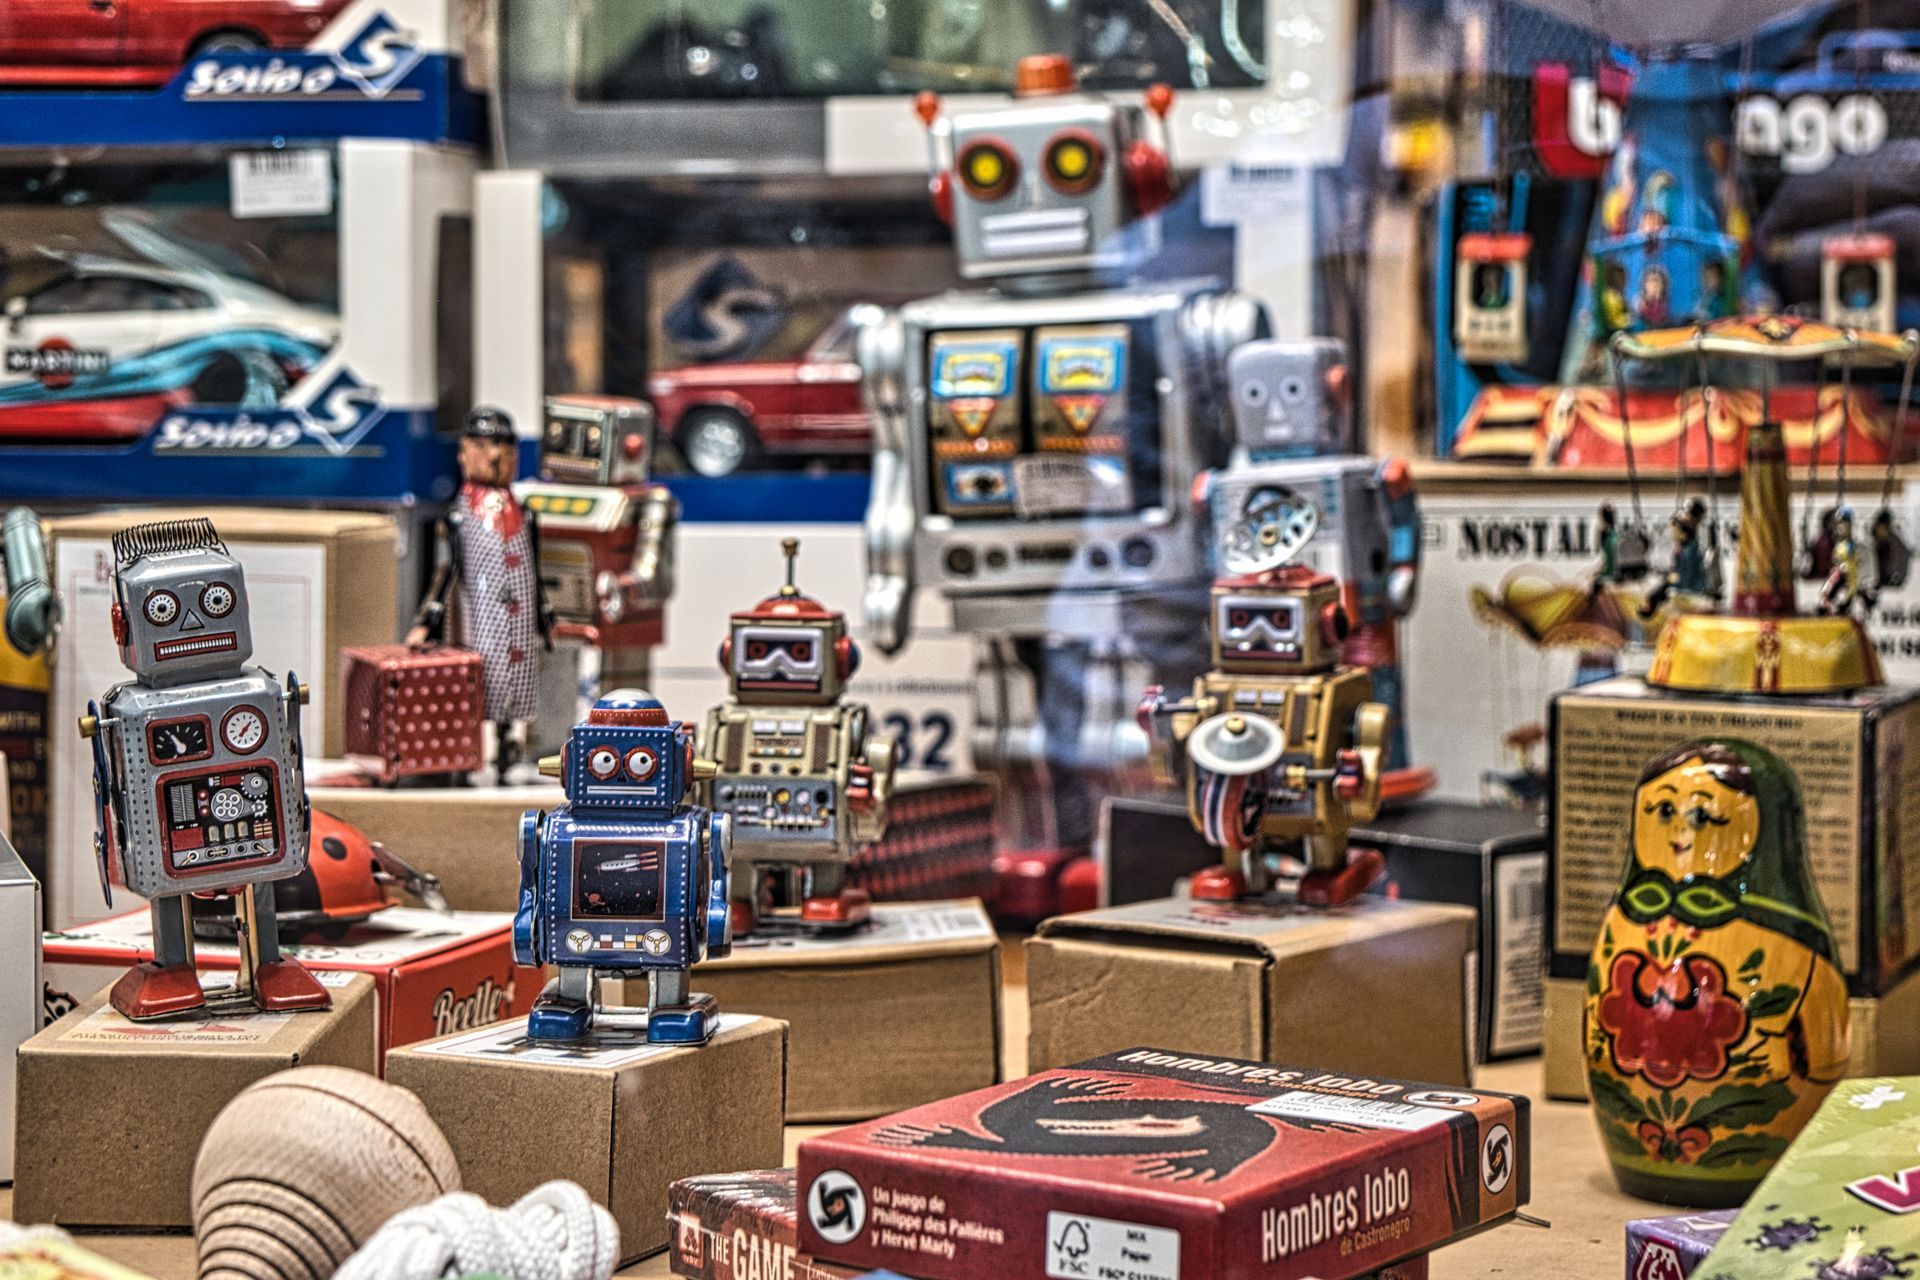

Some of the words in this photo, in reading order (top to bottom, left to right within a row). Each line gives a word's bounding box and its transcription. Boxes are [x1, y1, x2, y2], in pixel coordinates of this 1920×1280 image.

[432, 976, 503, 1037] Beetle
[1116, 1050, 1304, 1082] Hombres
[1302, 1074, 1404, 1095] lobo
[872, 1186, 890, 1204] Un
[928, 1195, 946, 1214] de
[1261, 1185, 1359, 1263] Hombres
[1364, 1165, 1410, 1224] lobo
[871, 1206, 922, 1232] Philippe
[923, 1215, 947, 1235] des
[1340, 1236, 1353, 1256] de
[1354, 1216, 1410, 1250] Castronegro
[710, 1231, 730, 1266] THE
[732, 1227, 798, 1280] GAME
[881, 1229, 918, 1251] Hervé
[919, 1234, 956, 1260] Marly
[1059, 1258, 1089, 1275] FSC
